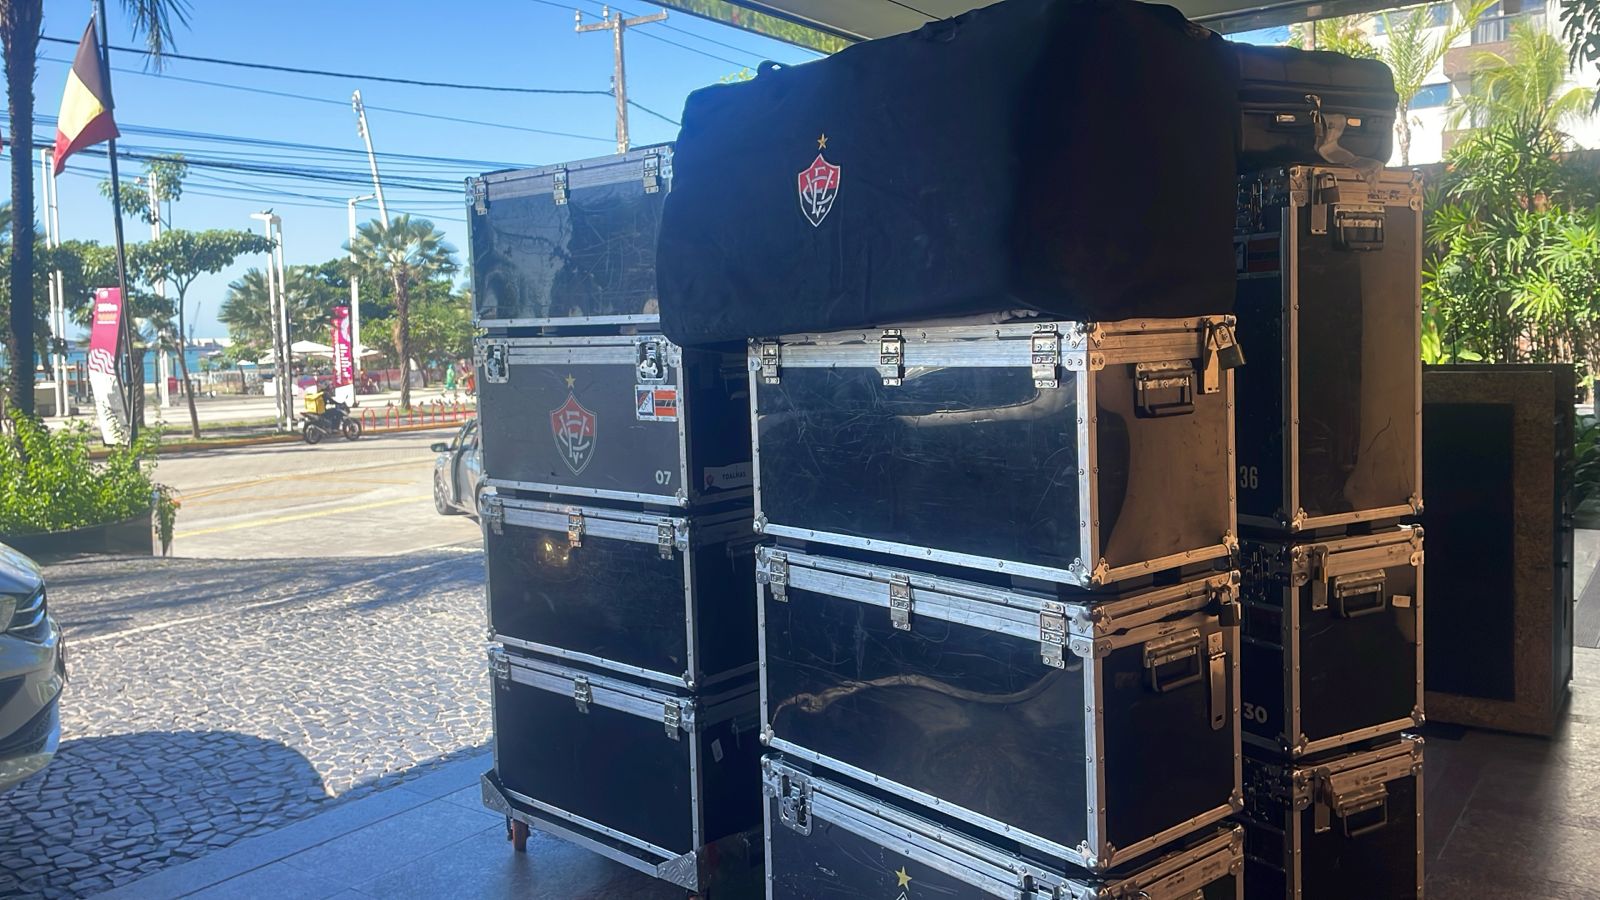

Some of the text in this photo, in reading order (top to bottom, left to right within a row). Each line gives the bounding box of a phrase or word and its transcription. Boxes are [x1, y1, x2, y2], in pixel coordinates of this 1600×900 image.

[655, 469, 672, 485] 07
[1240, 465, 1258, 489] 36
[1243, 702, 1268, 724] 30
